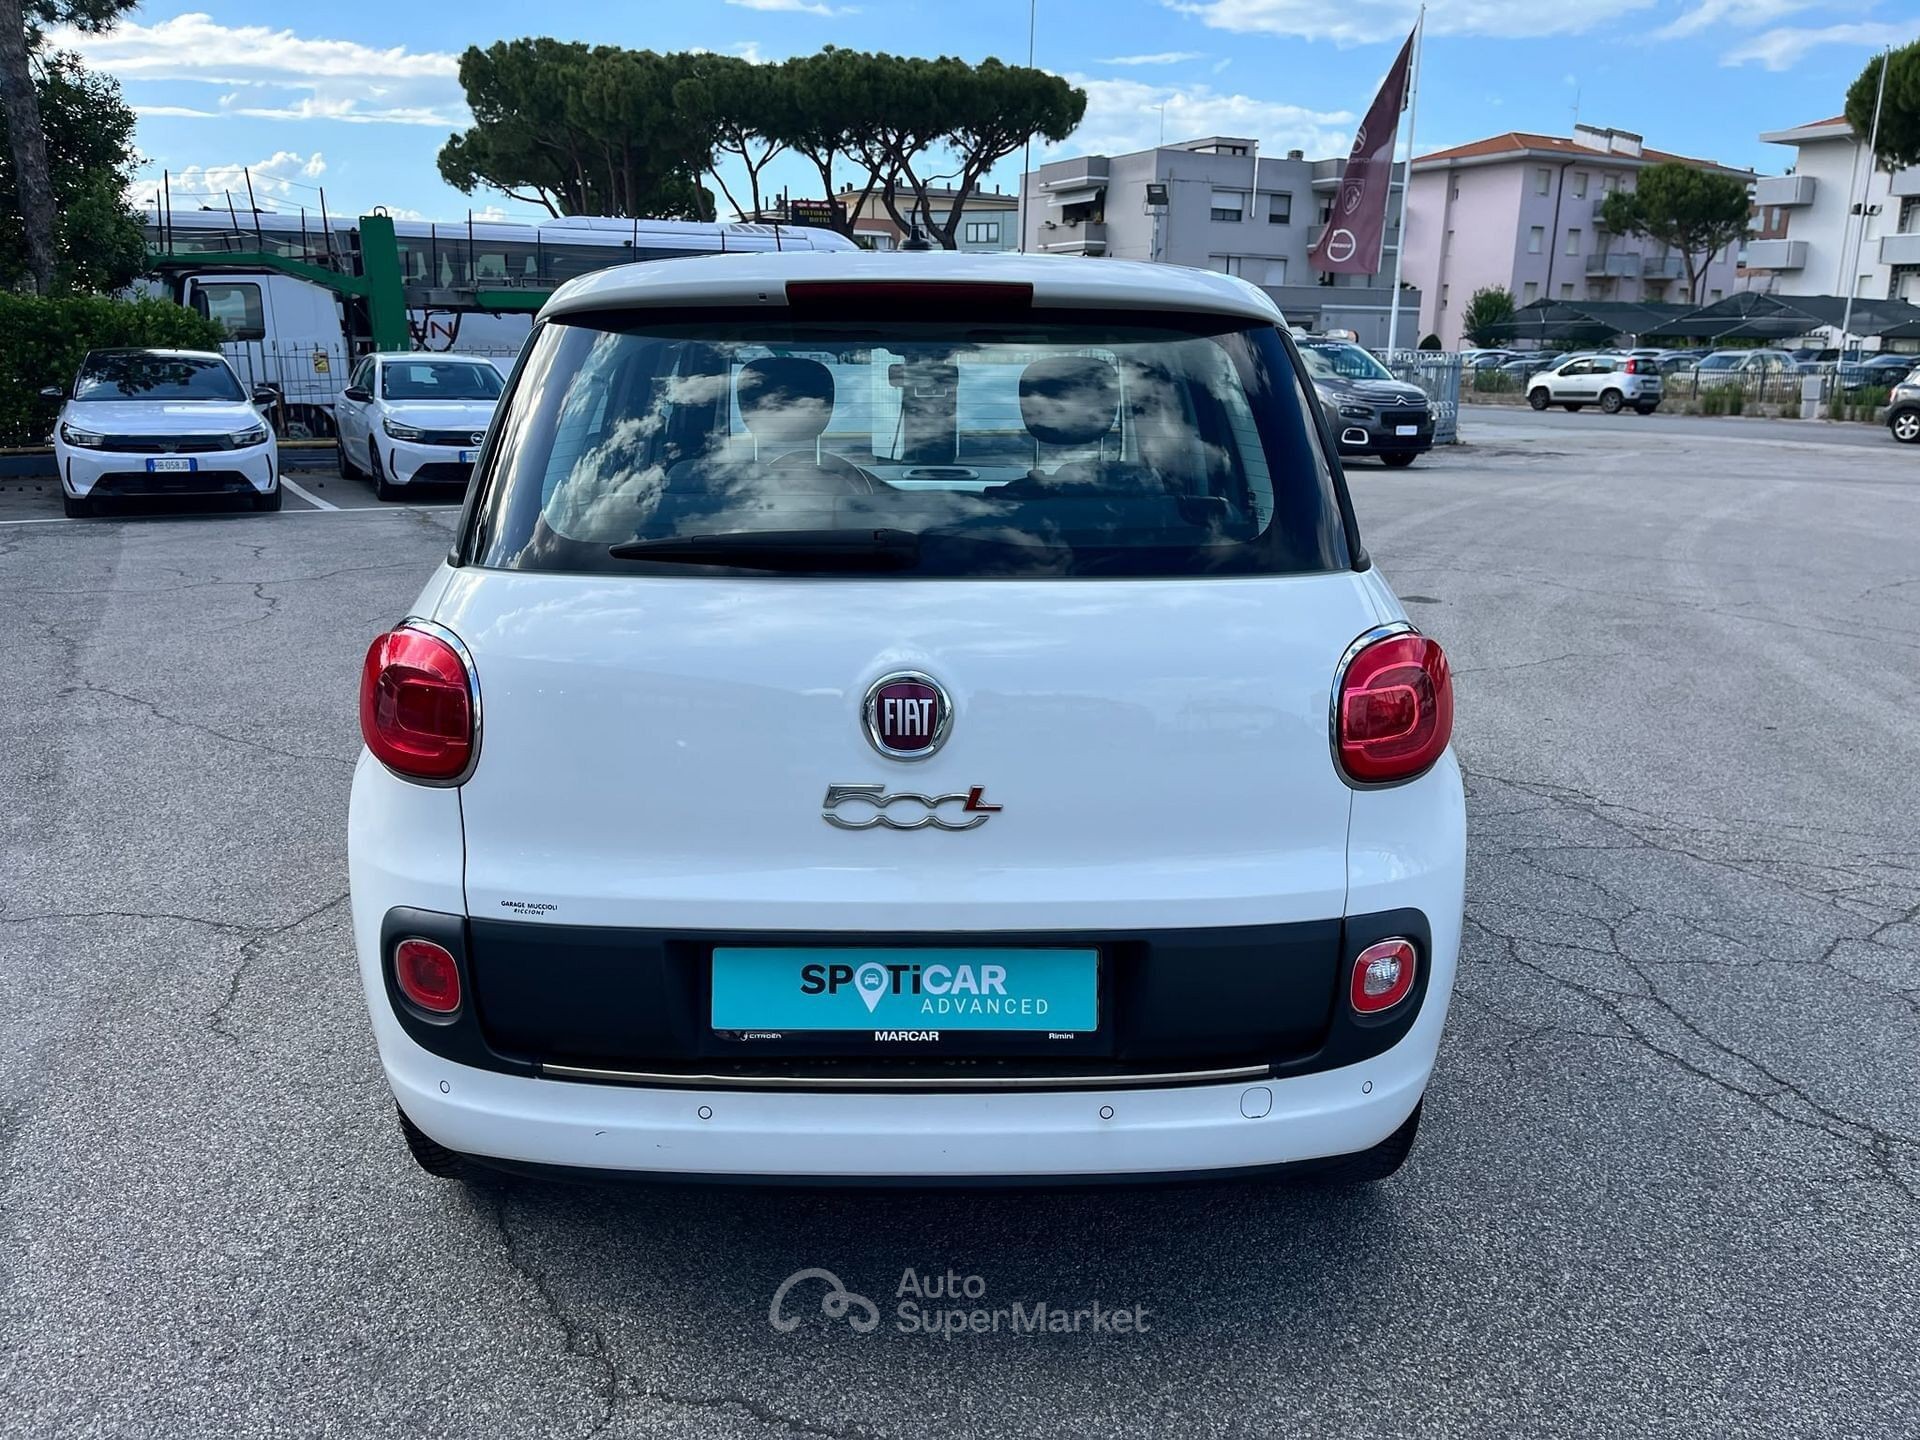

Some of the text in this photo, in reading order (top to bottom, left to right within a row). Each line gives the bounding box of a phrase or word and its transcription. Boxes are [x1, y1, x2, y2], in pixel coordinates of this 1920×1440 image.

[799, 209, 832, 217] RISTORAN
[884, 698, 933, 736] FIAT
[822, 783, 1003, 832] 500L
[500, 900, 558, 911] GARAGE MUCCIOLI
[513, 908, 545, 916] RICCIONE
[920, 998, 1048, 1015] ADVANCED
[874, 1031, 940, 1042] MARCAR
[1048, 1032, 1074, 1040] Rimini
